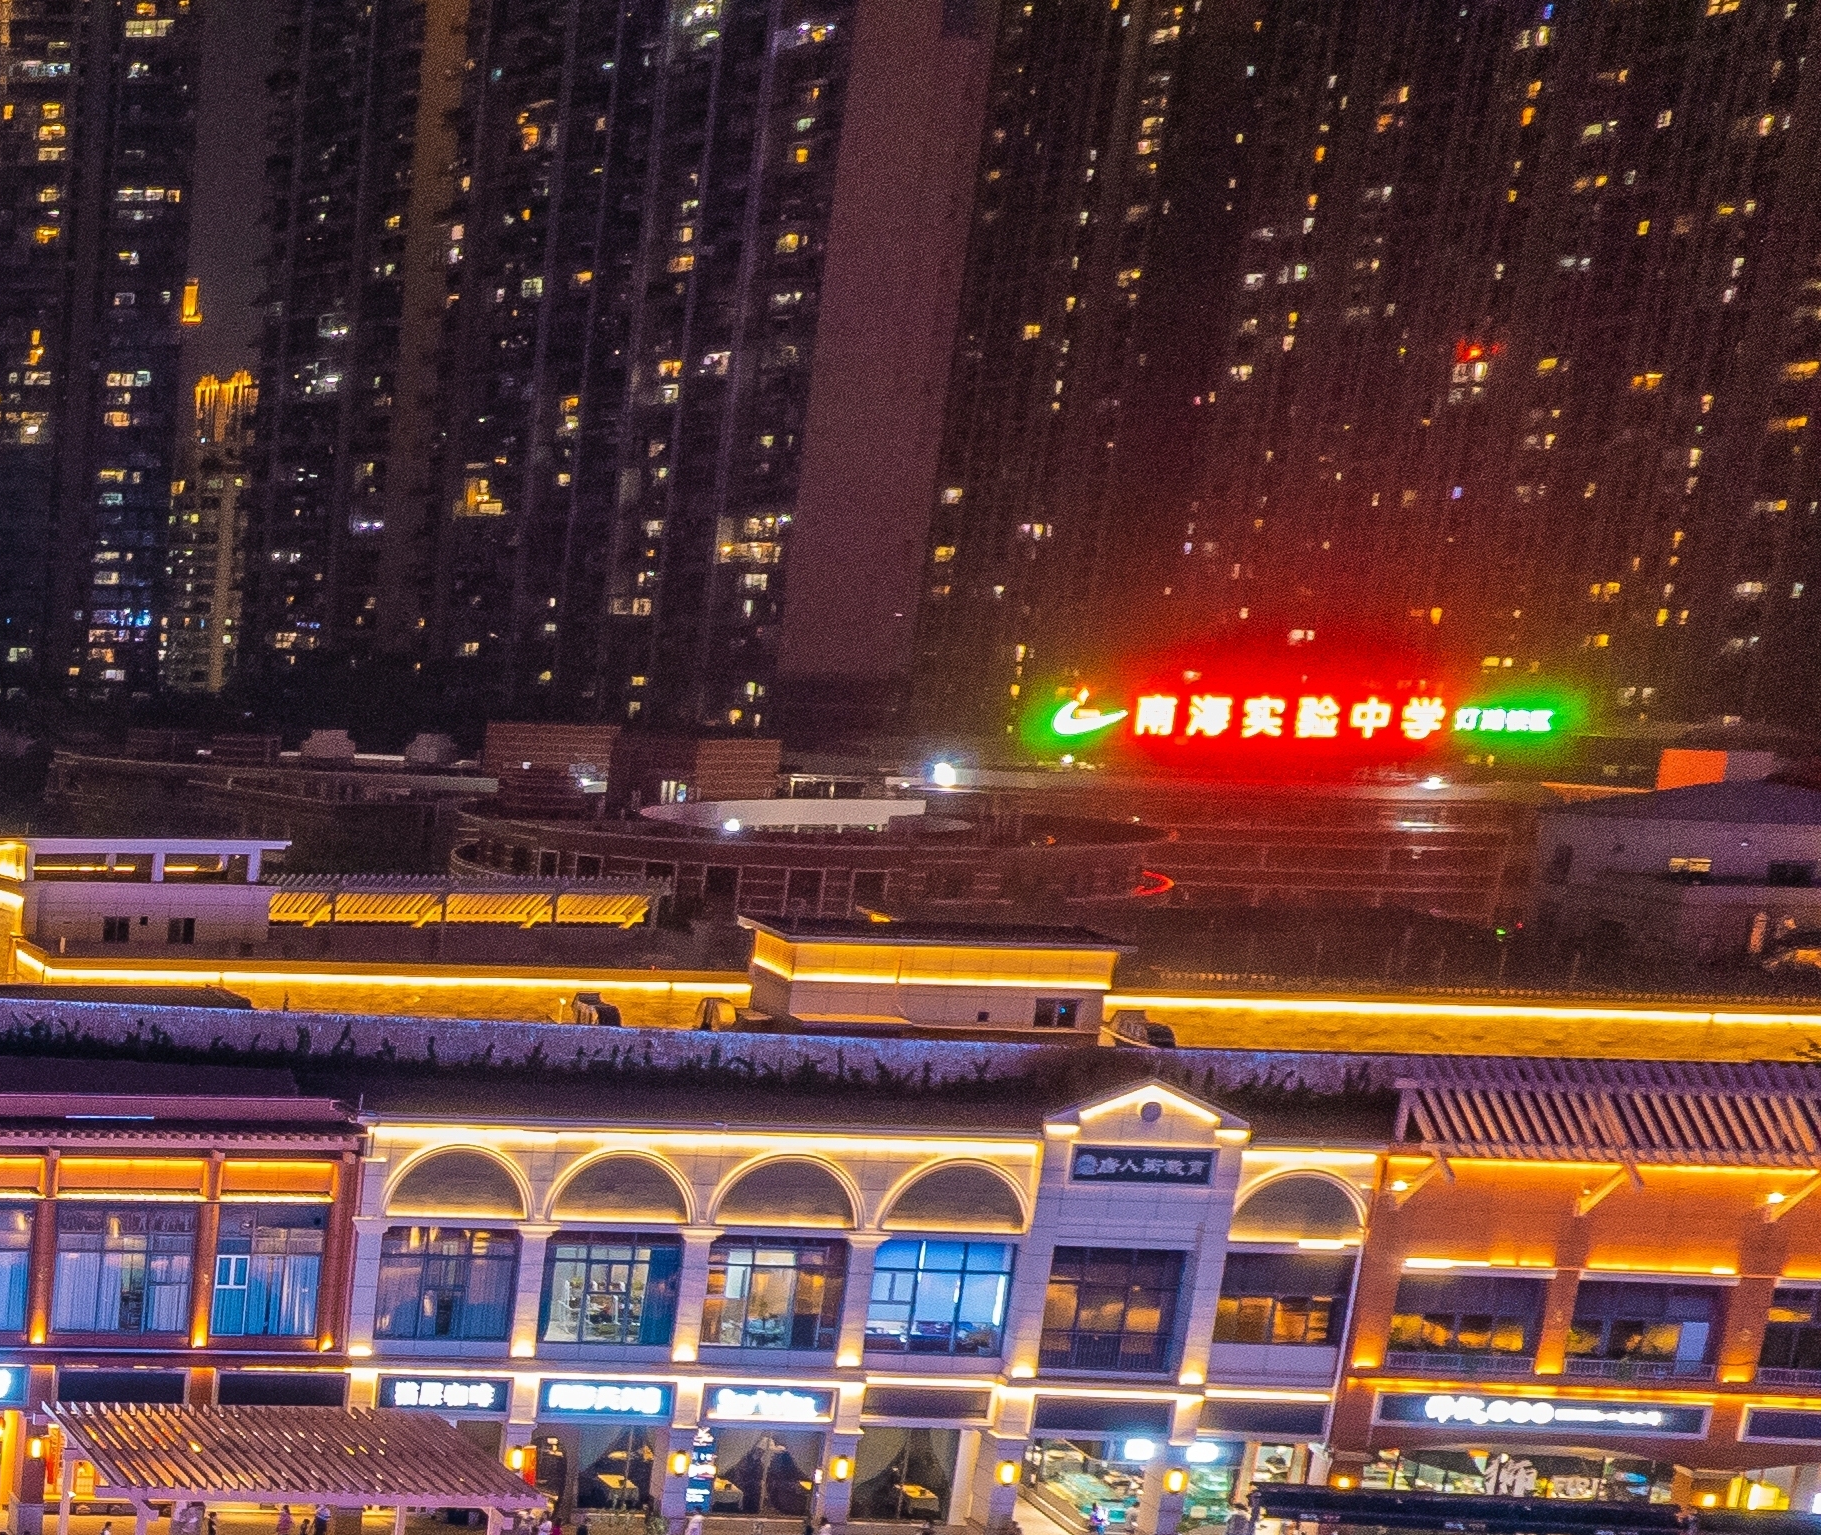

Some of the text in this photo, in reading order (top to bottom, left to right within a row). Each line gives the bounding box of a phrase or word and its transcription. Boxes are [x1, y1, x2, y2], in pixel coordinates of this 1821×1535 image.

[1134, 694, 1447, 739] 南海实验中学
